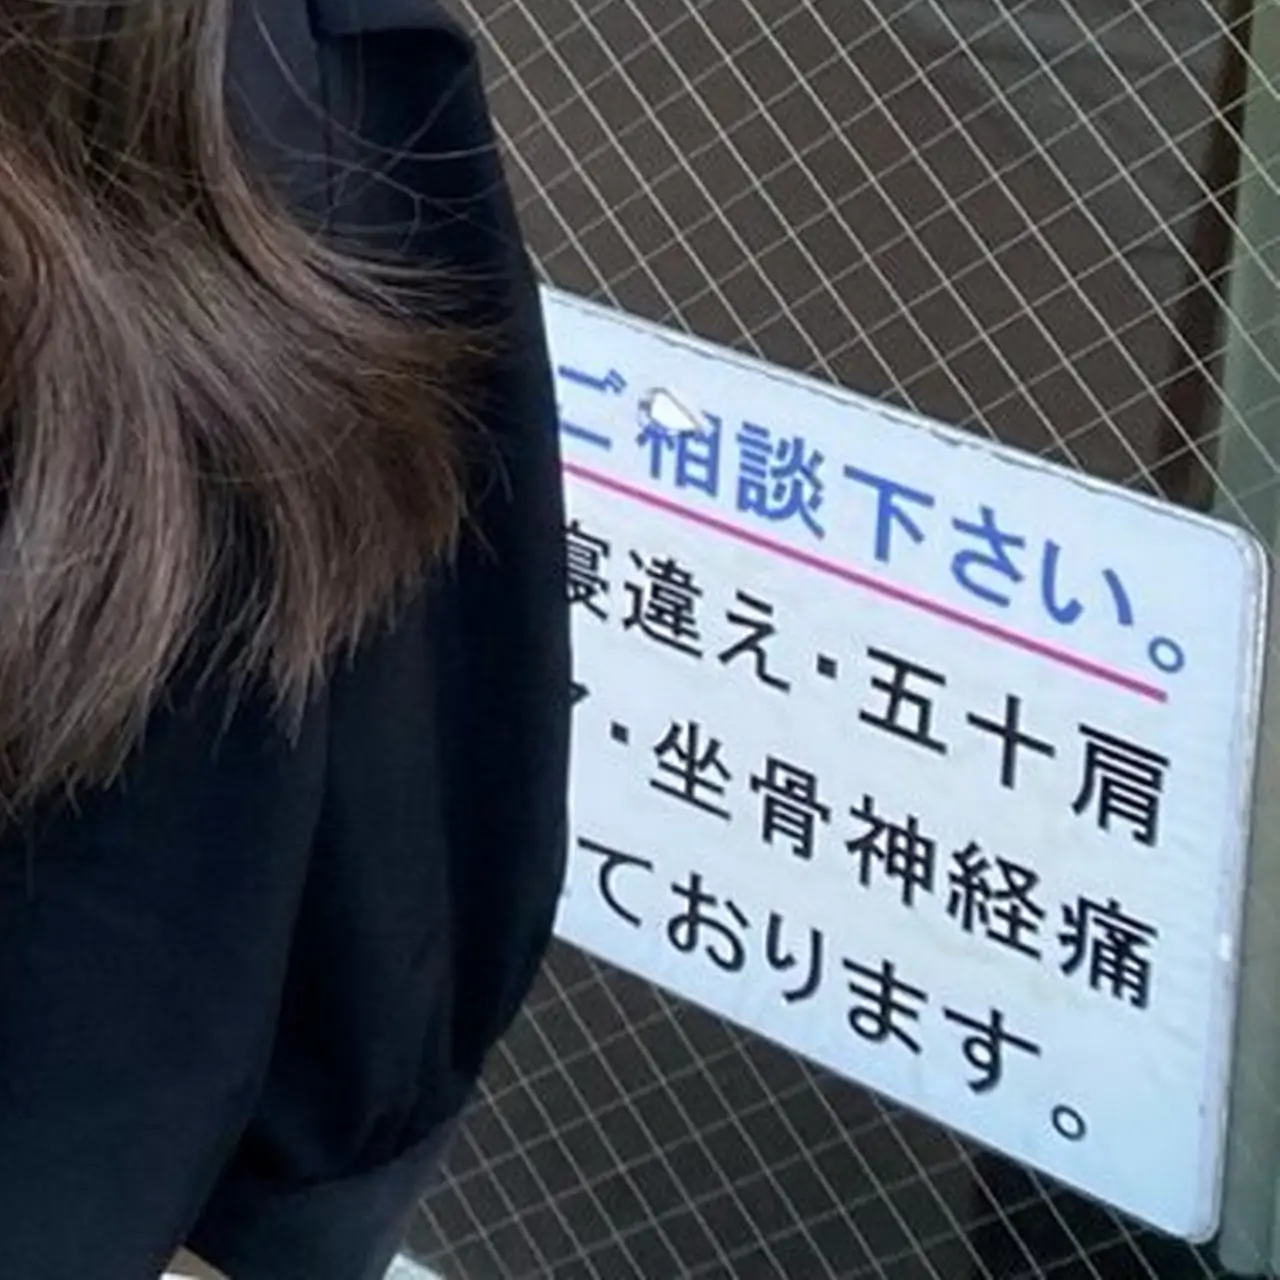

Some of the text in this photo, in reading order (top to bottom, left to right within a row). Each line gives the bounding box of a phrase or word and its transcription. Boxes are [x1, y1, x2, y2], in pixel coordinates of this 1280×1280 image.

[571, 680, 1160, 1012] ・坐骨神経痛
[575, 836, 1089, 1143] ております。
